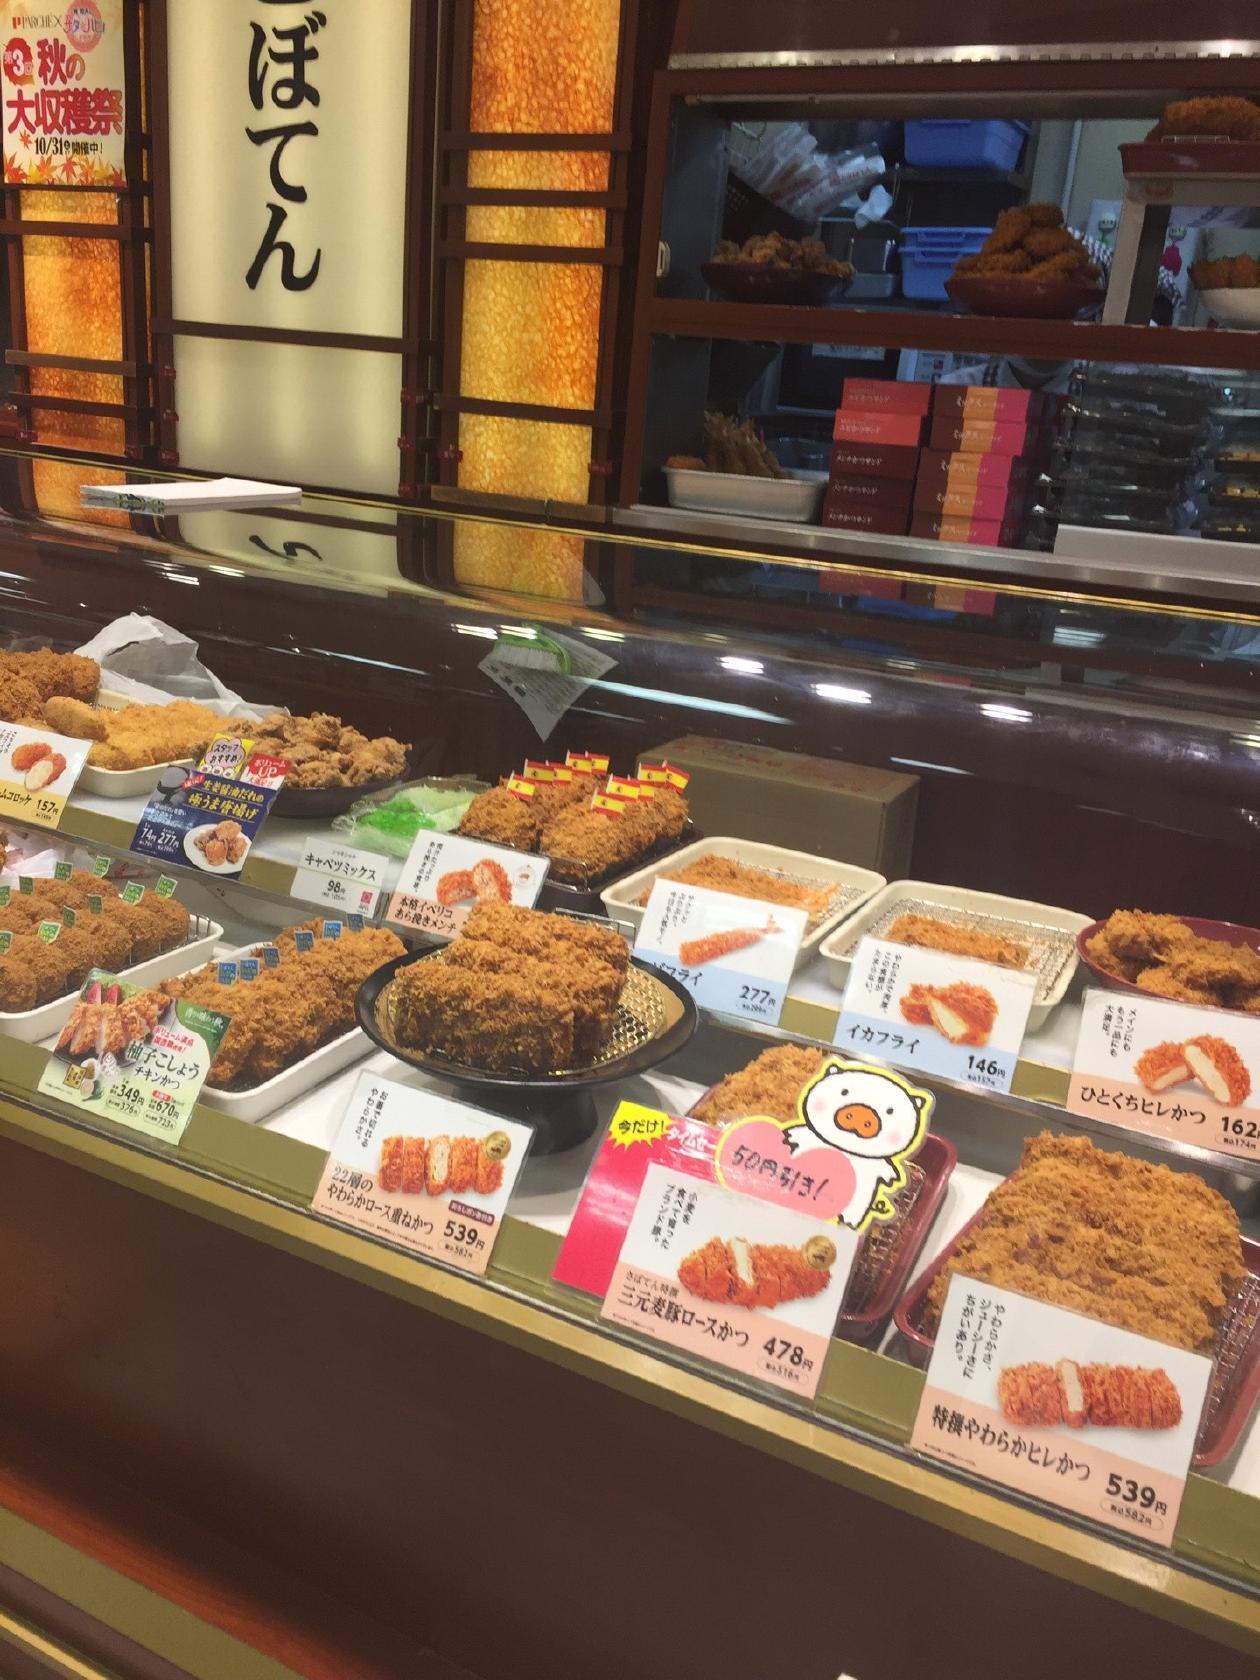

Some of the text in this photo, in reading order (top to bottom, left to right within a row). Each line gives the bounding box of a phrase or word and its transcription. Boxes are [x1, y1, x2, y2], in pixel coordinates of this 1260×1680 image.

[37, 37, 86, 85] 秋の
[6, 88, 123, 136] 大収穫祭
[246, 0, 327, 291] ぼてん
[208, 753, 244, 766] おすすめ!
[213, 742, 240, 755] スタッフ
[258, 764, 279, 779] UP
[37, 799, 59, 816] 157円
[140, 827, 157, 843] 74円
[157, 831, 180, 849] 277円
[304, 852, 377, 881] キャベツミックス
[327, 880, 346, 895] 98円
[400, 895, 454, 918] 本格イベリコ
[394, 907, 457, 933] あら挽きメンチ
[739, 985, 776, 1007] 277円
[848, 1024, 920, 1054] イカフライ
[127, 1041, 200, 1080] 柚子こしょう
[967, 1055, 1006, 1078] 146円
[134, 1065, 180, 1090] チキンかつ
[117, 1084, 145, 1106] 349円
[1080, 1086, 1207, 1125] ひとくちヒレかつ
[155, 1100, 180, 1120] 670円
[618, 1119, 666, 1135] 今だけ!
[332, 1166, 373, 1191] 22層の
[730, 1145, 830, 1200] 50円引き!
[326, 1184, 434, 1235] やわらかロース重ねかつ
[443, 1220, 486, 1250] 539円
[617, 1284, 750, 1347] 三元麦豚ロースかつ
[762, 1336, 814, 1372] 478円
[931, 1404, 1091, 1481] 特撰やわらかヒレかつ
[1105, 1472, 1168, 1516] 539円
